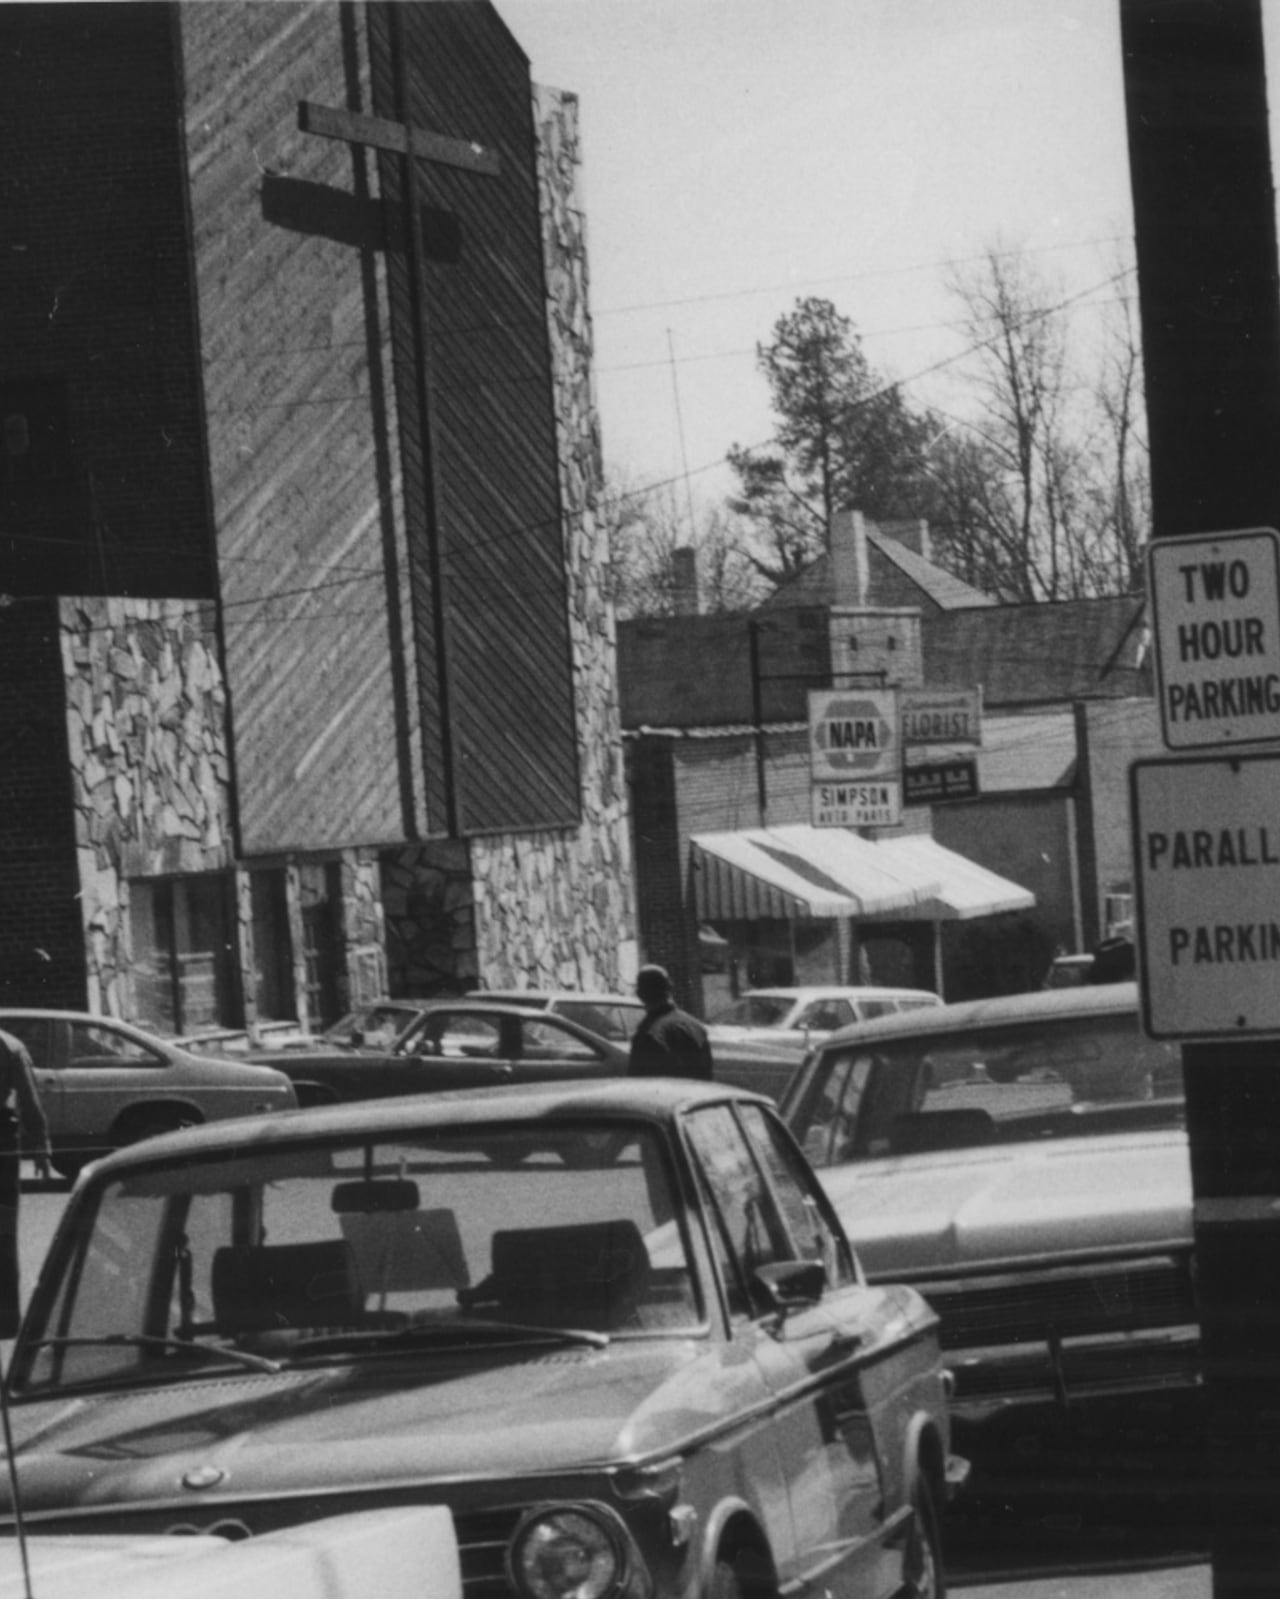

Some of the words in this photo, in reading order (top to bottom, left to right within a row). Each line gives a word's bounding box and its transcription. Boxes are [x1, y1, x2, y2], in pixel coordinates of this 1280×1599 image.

[1179, 559, 1250, 603] TWO
[1178, 617, 1266, 662] HOUR
[829, 721, 878, 749] NAPA
[901, 712, 970, 737] FLORIST
[821, 787, 890, 807] SIMPSON
